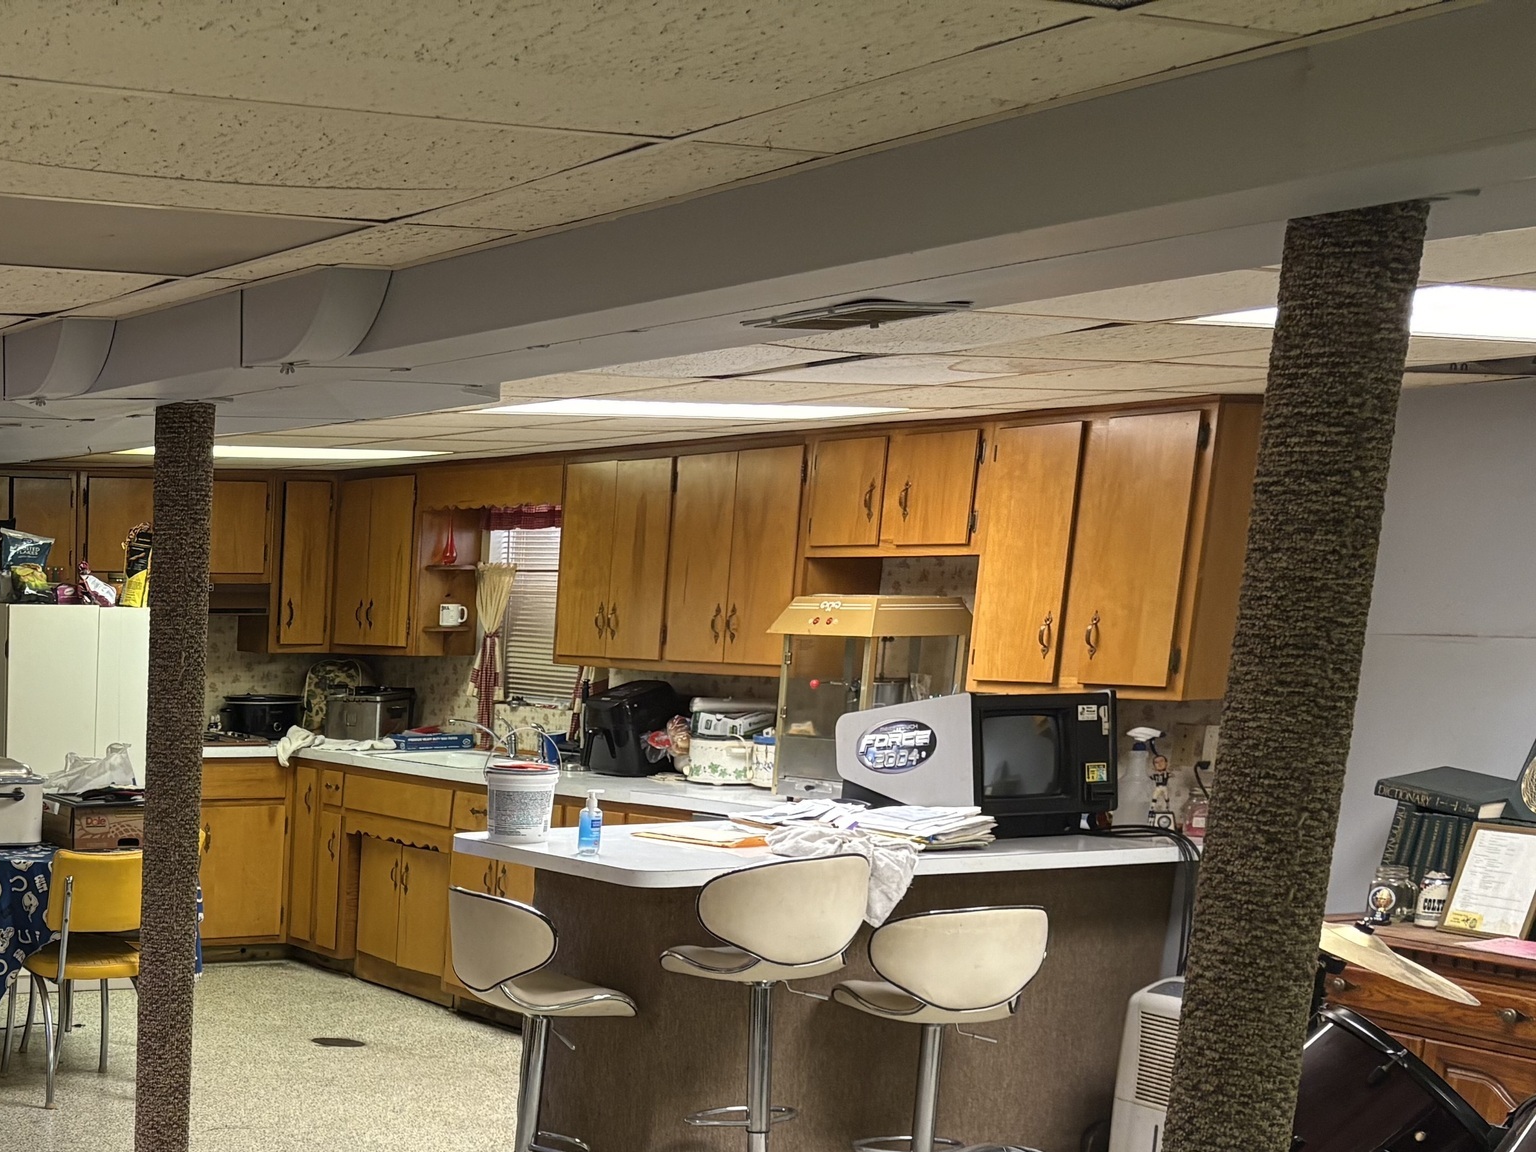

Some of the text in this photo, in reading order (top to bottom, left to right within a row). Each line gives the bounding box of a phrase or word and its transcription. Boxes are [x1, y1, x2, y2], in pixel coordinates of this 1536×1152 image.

[859, 730, 932, 755] FORCE
[873, 749, 920, 769] 2004
[1378, 784, 1432, 807] DICTIONARY
[85, 816, 106, 827] Dole
